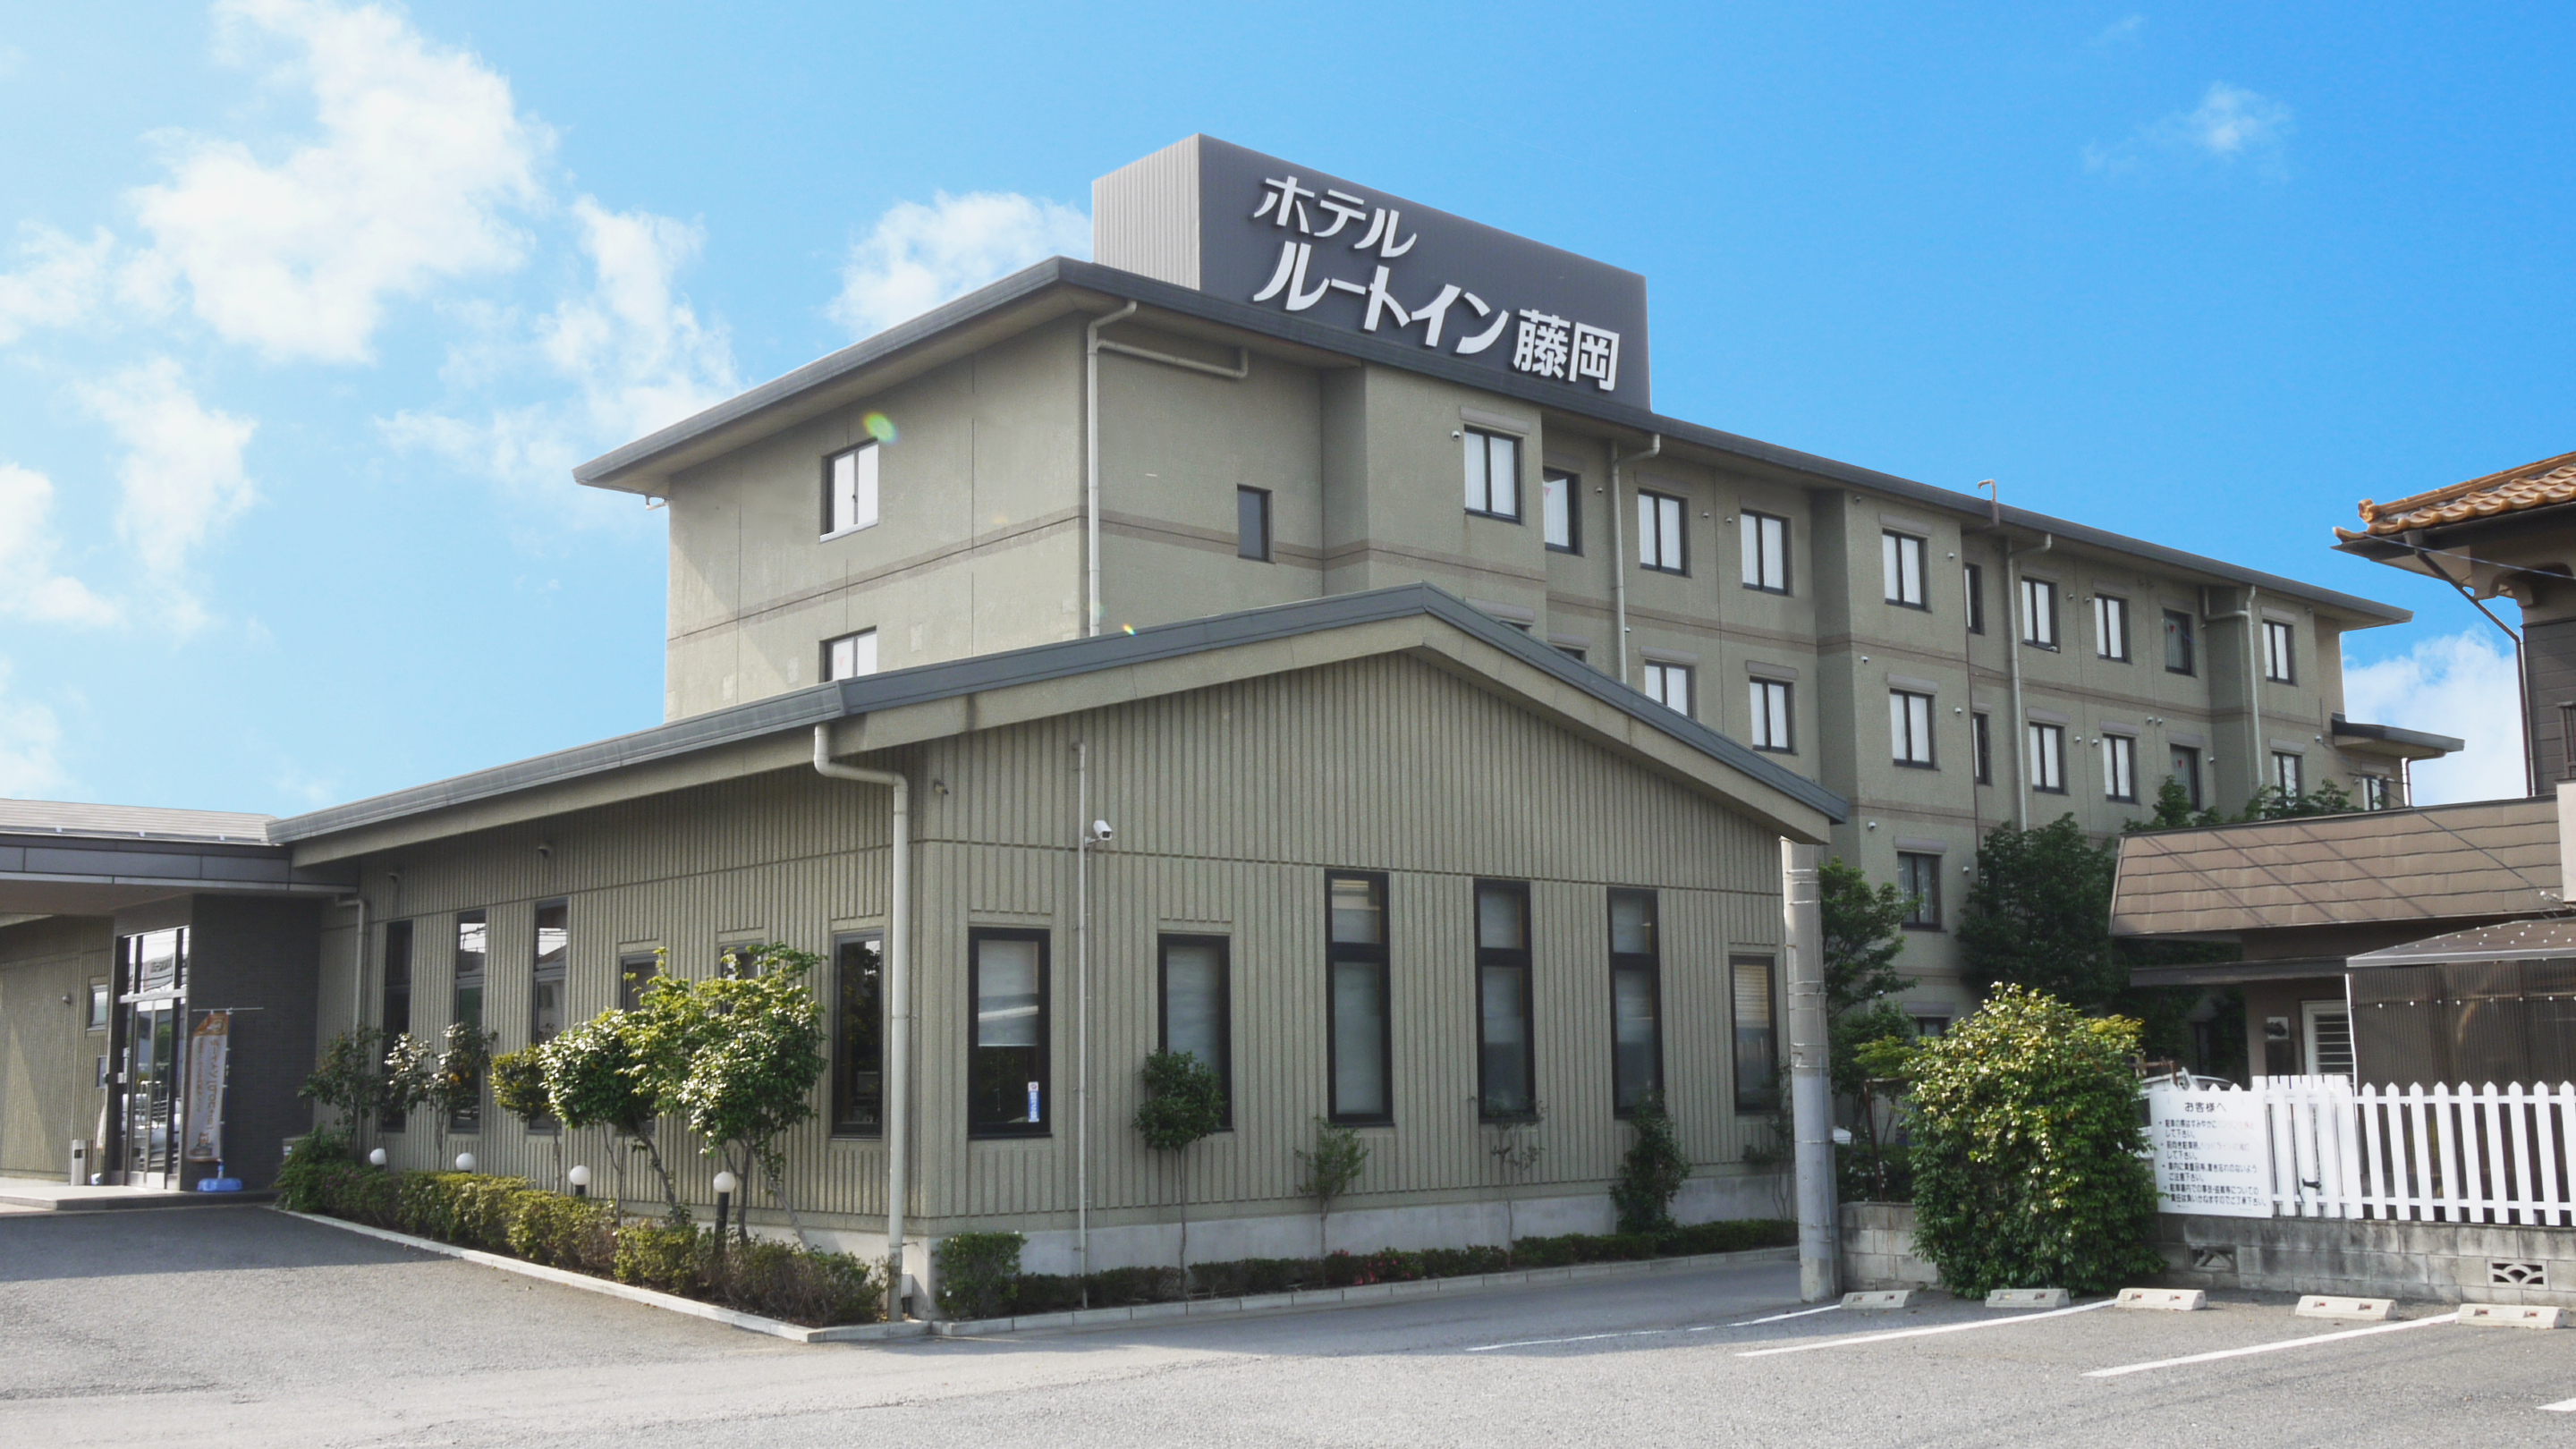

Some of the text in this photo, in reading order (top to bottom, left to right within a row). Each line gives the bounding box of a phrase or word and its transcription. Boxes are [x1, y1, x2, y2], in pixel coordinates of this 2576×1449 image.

[1253, 175, 1418, 258] ホテル
[1253, 240, 1621, 392] ルートイン藤岡
[2184, 1101, 2226, 1113] お客様へ
